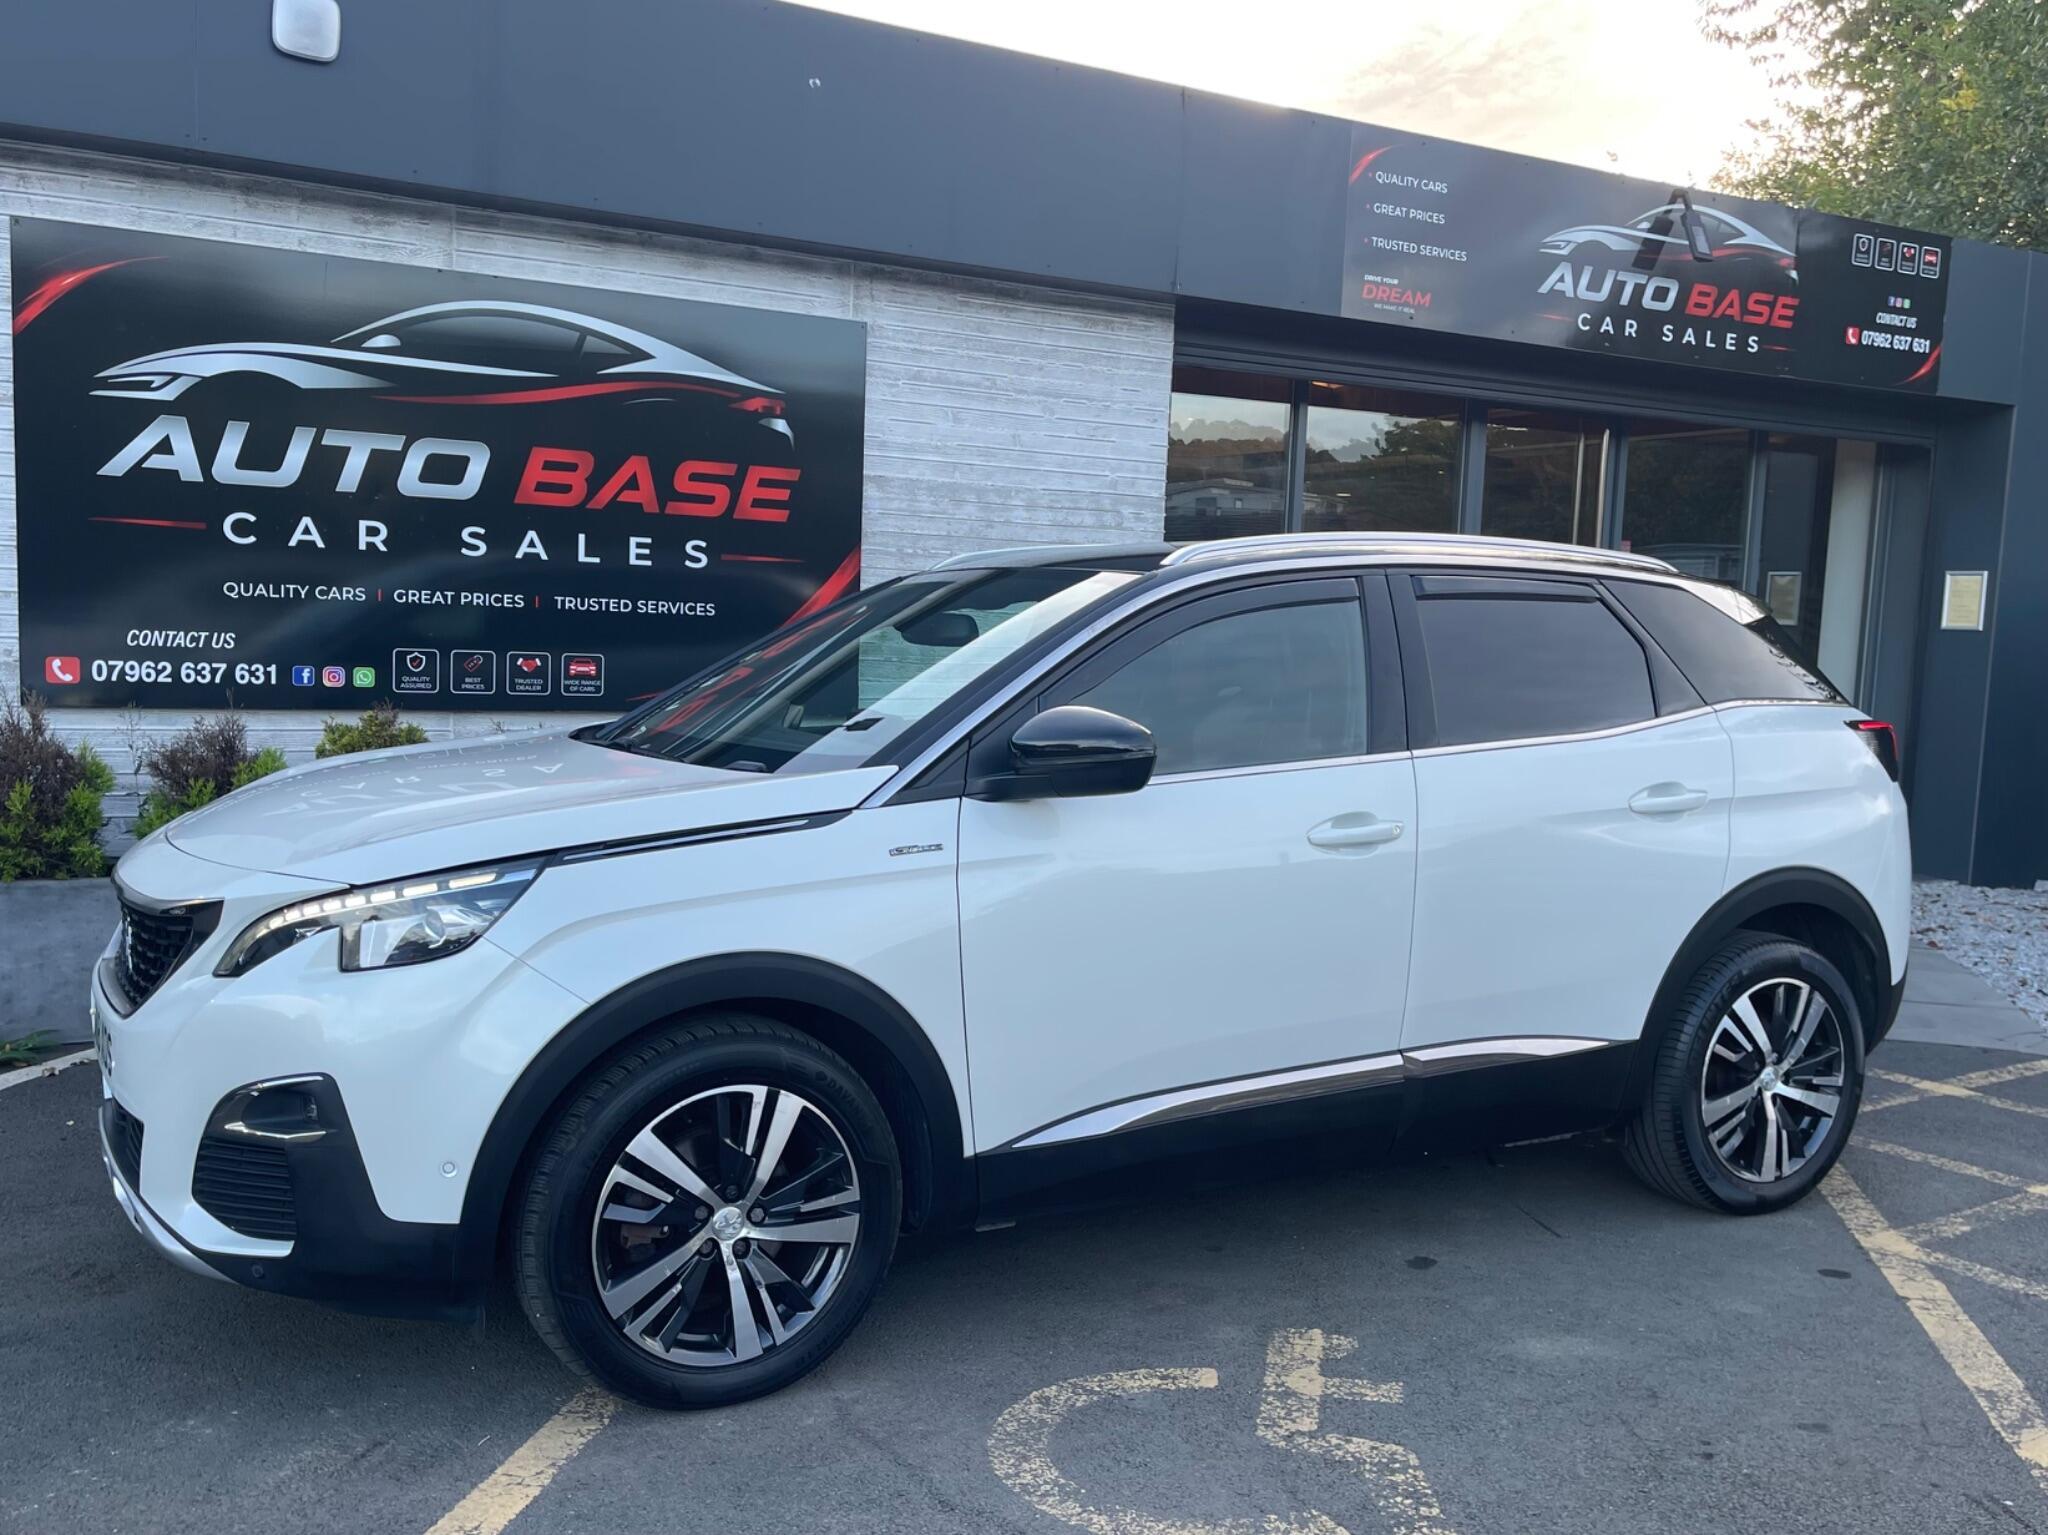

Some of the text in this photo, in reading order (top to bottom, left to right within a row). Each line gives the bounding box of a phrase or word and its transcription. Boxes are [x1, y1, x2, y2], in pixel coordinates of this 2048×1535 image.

[1375, 171, 1448, 194] QUALITY CARS
[1373, 203, 1445, 224] GREAT PRICES
[1371, 236, 1467, 262] TRUSTED SERVICES
[1362, 283, 1432, 308] DREAM
[1537, 261, 1800, 329] AUTO BASE
[1577, 312, 1759, 353] CAR SALES
[1876, 312, 1917, 329] CONTACT US
[1861, 330, 1930, 354] 07962 637 631
[96, 414, 801, 522] AUTO BASE
[222, 511, 709, 569] CAR SALES
[223, 581, 716, 617] QUALITY CARS GREAT PRICES TRUSTED SERVICES
[126, 629, 236, 649] CONTACT US
[91, 660, 278, 685] 07962 637 631
